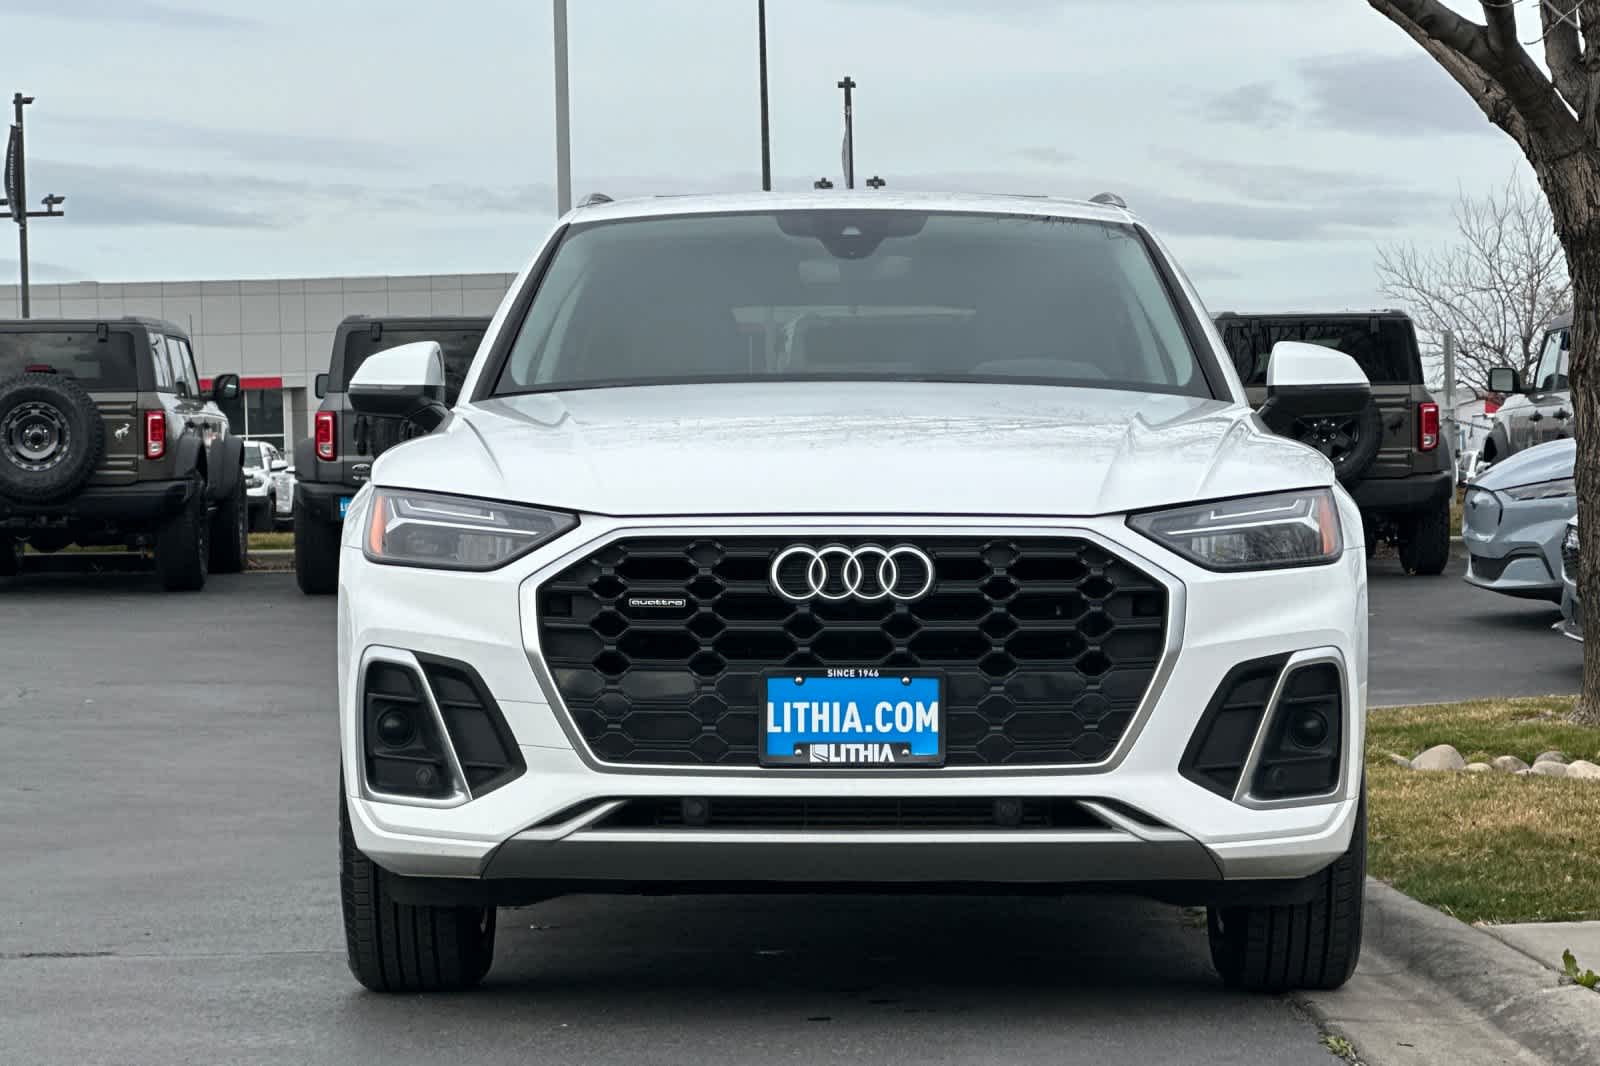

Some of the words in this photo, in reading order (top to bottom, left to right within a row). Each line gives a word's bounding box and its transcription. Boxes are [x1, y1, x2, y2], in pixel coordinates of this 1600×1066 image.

[630, 599, 684, 607] quattro
[827, 669, 855, 678] SINCE
[858, 669, 880, 678] 1946
[767, 701, 939, 733] LITHIA.COM
[829, 743, 895, 763] LITHIA
